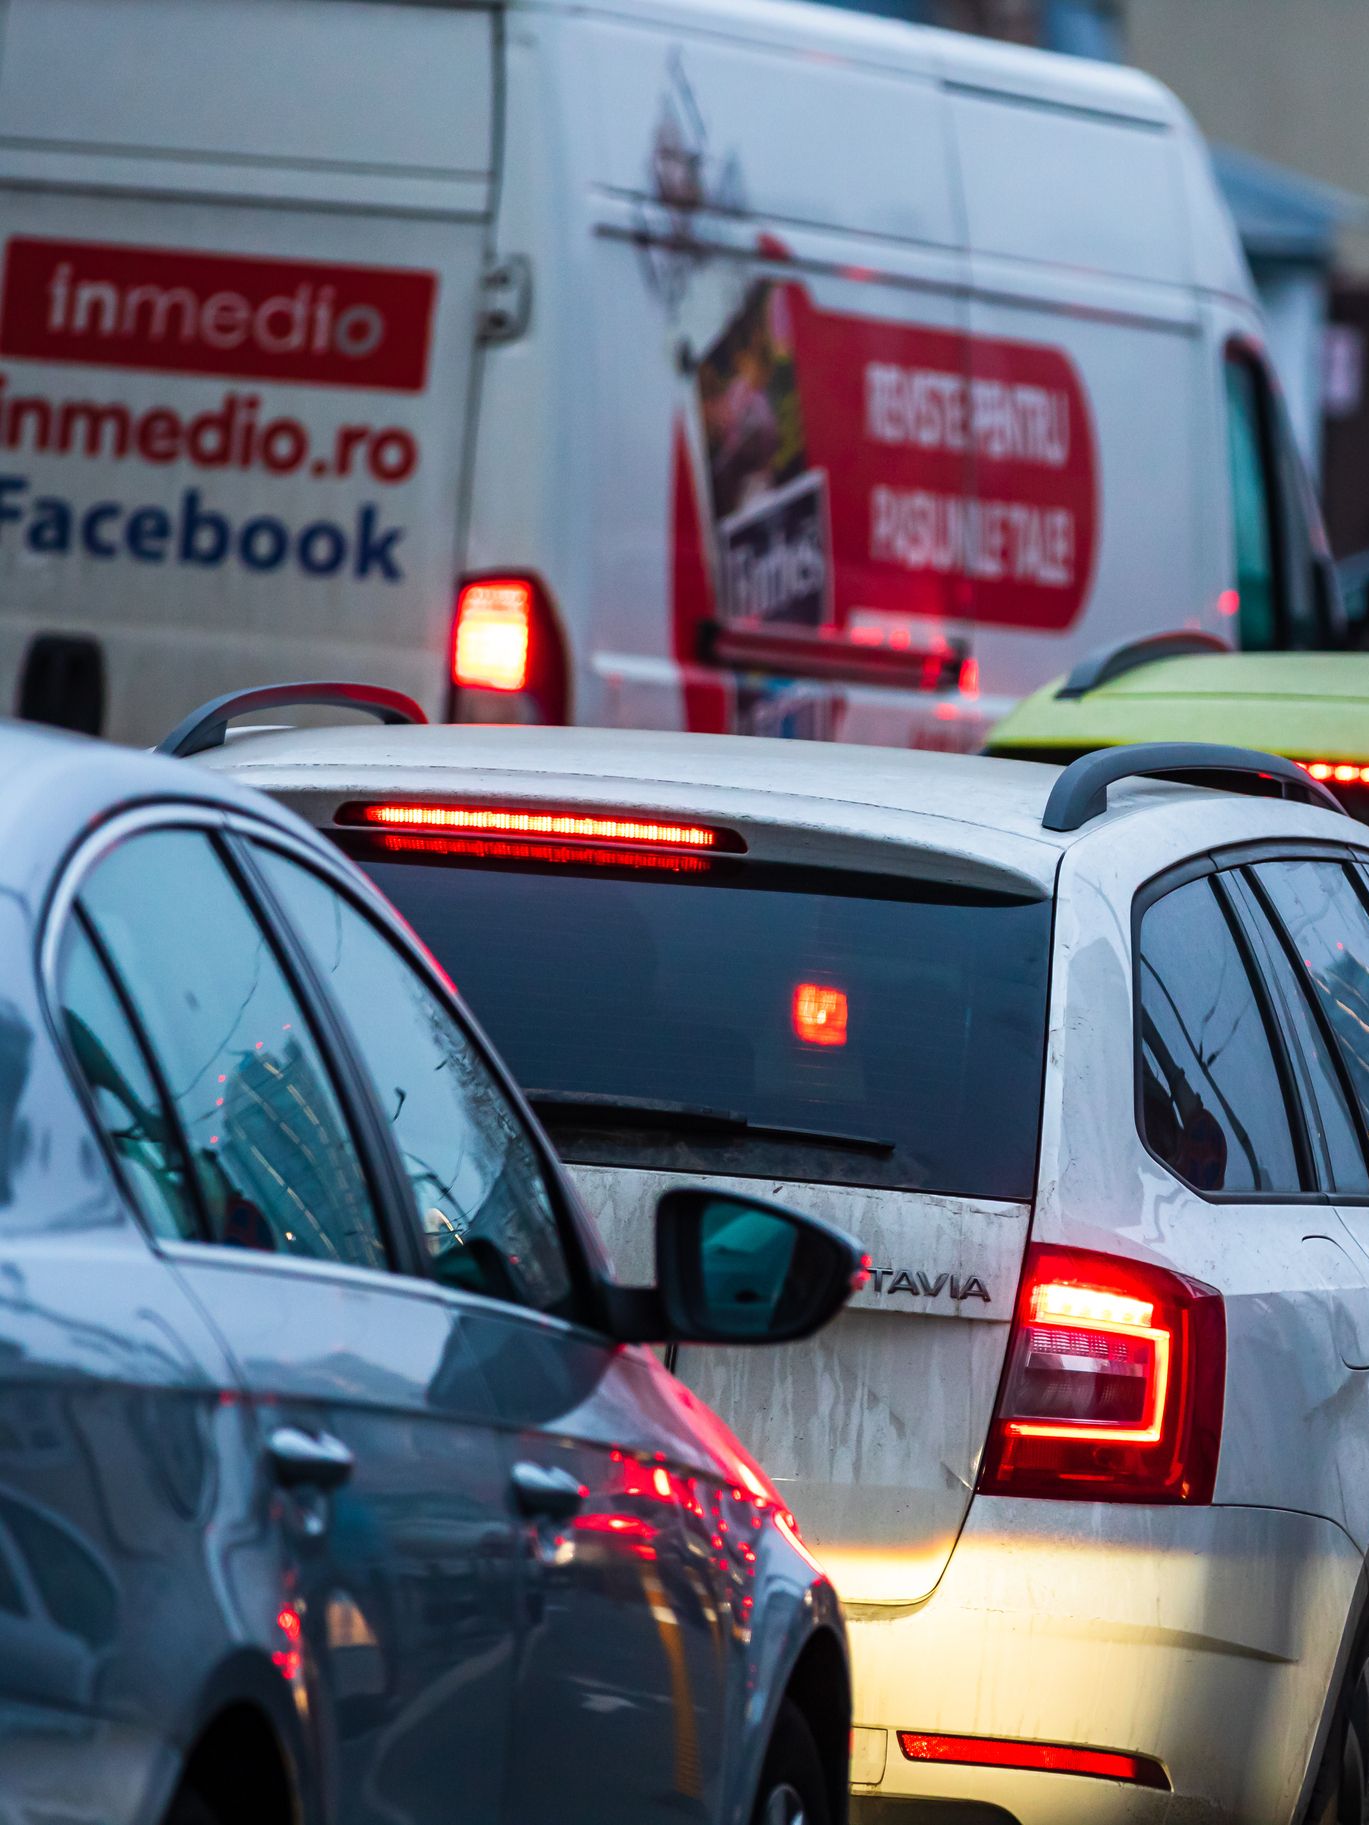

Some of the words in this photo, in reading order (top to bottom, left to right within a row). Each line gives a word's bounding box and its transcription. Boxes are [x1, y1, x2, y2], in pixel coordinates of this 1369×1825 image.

[48, 263, 384, 355] inmedio
[0, 374, 417, 483] nmedio.ro
[867, 1266, 991, 1303] TAVIA
